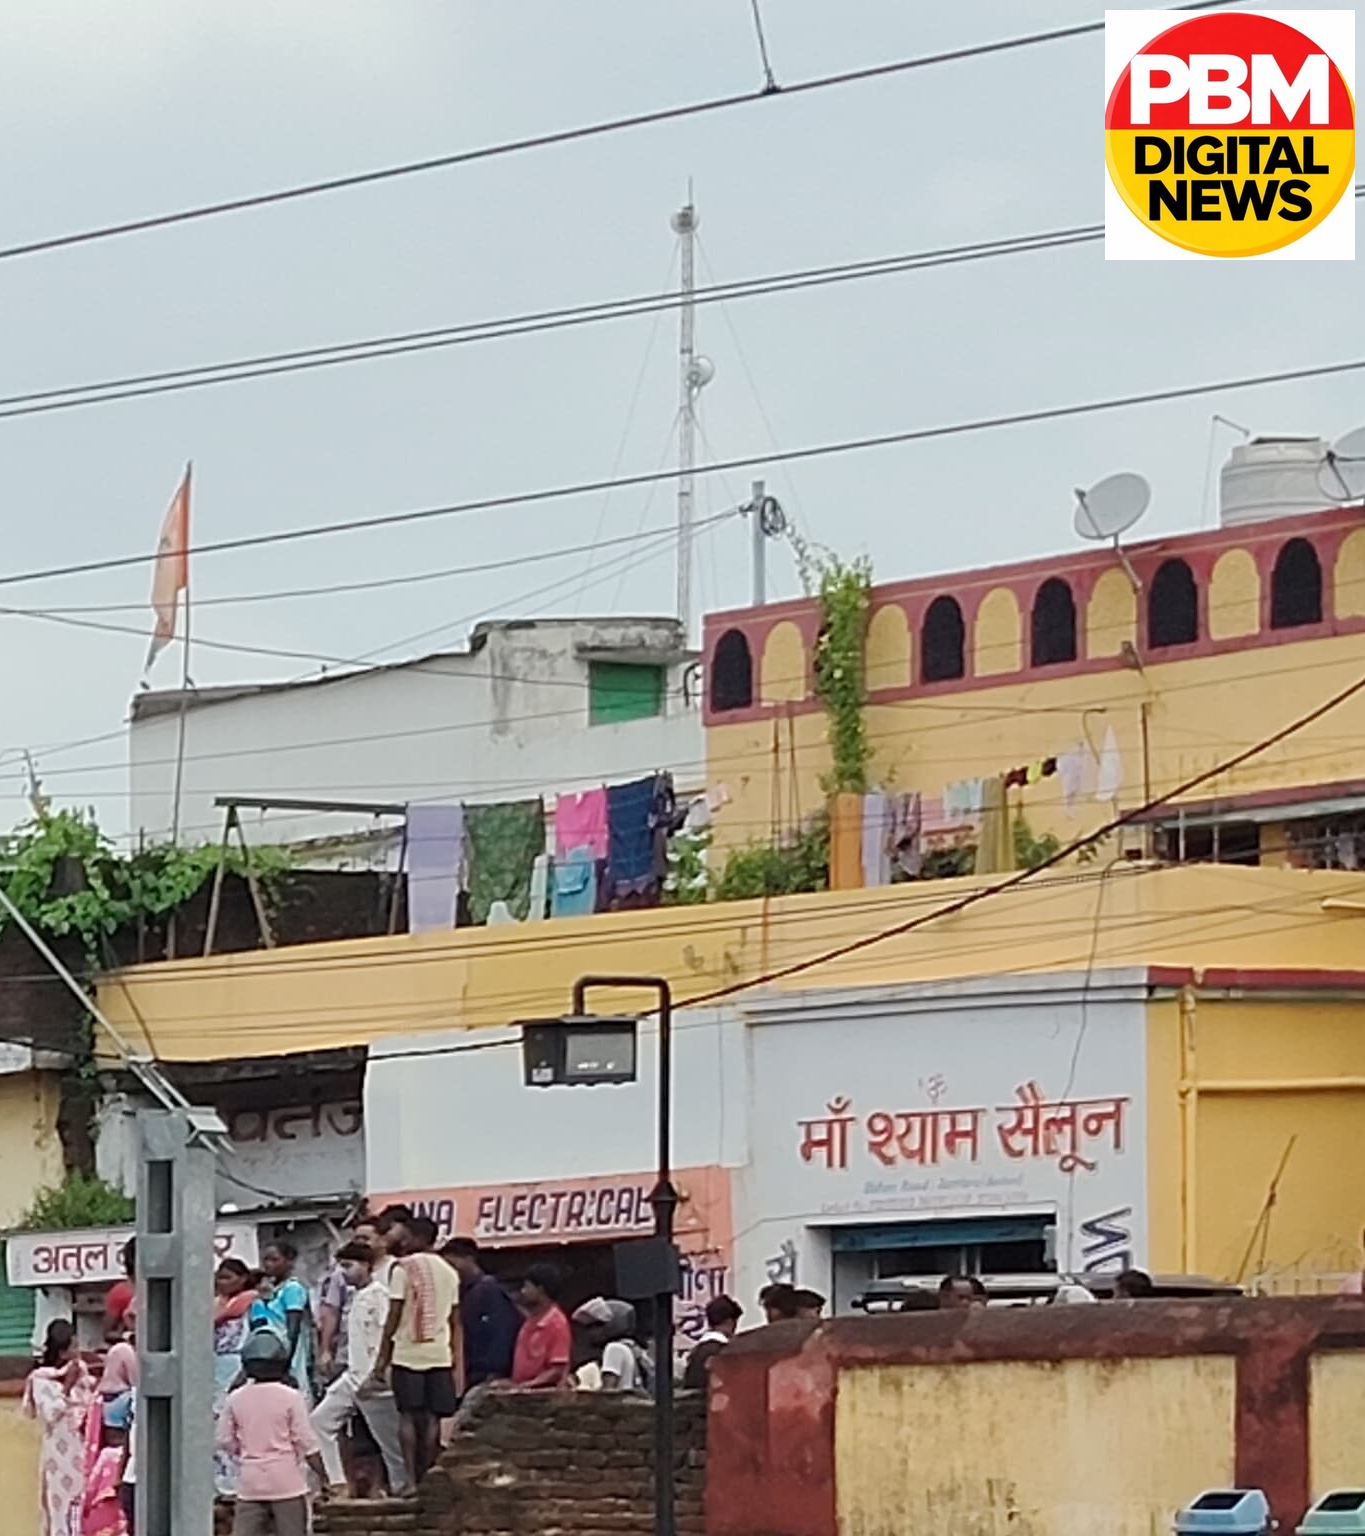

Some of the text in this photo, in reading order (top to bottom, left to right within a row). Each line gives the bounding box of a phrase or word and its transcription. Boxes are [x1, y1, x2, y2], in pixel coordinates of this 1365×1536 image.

[797, 1082, 1130, 1173] माँ श्याम सैलून
[33, 1243, 108, 1279] अतुल
